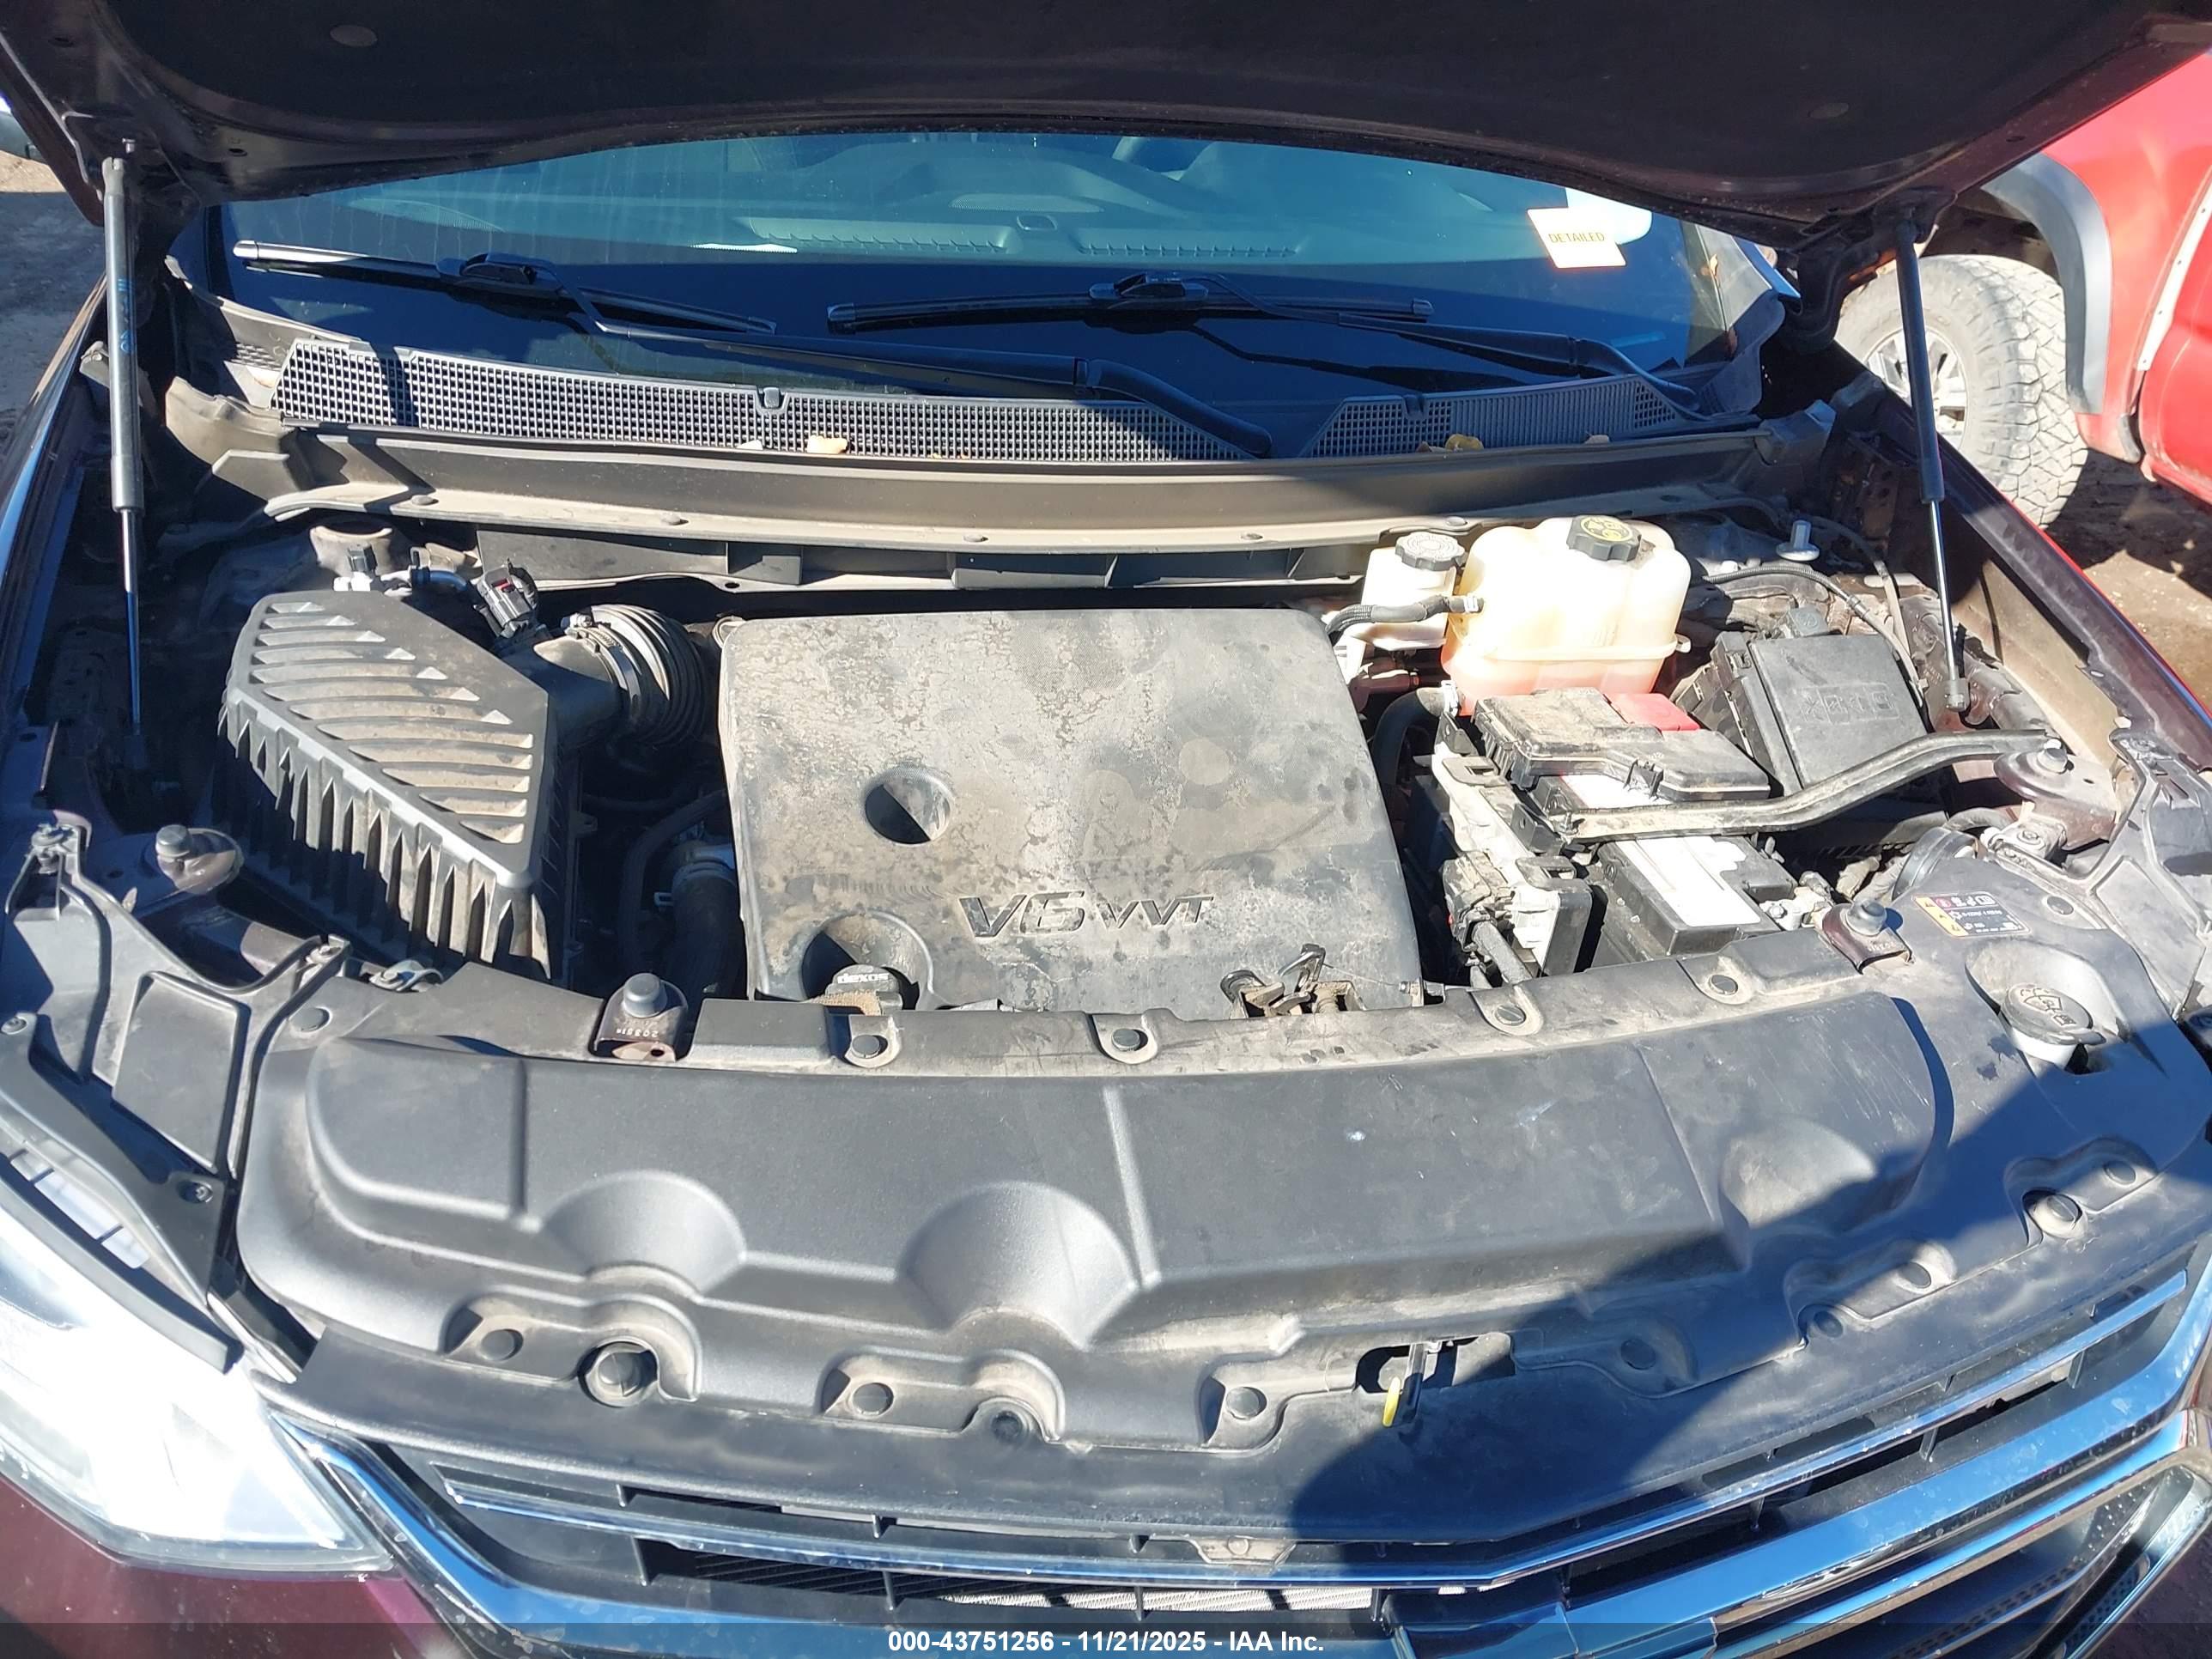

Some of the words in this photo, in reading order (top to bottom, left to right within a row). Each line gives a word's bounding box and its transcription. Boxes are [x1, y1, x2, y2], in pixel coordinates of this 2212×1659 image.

[1547, 232, 1606, 244] DETAILED
[958, 890, 1085, 939] V6
[1097, 893, 1215, 929] VVT
[837, 972, 890, 984] dexos
